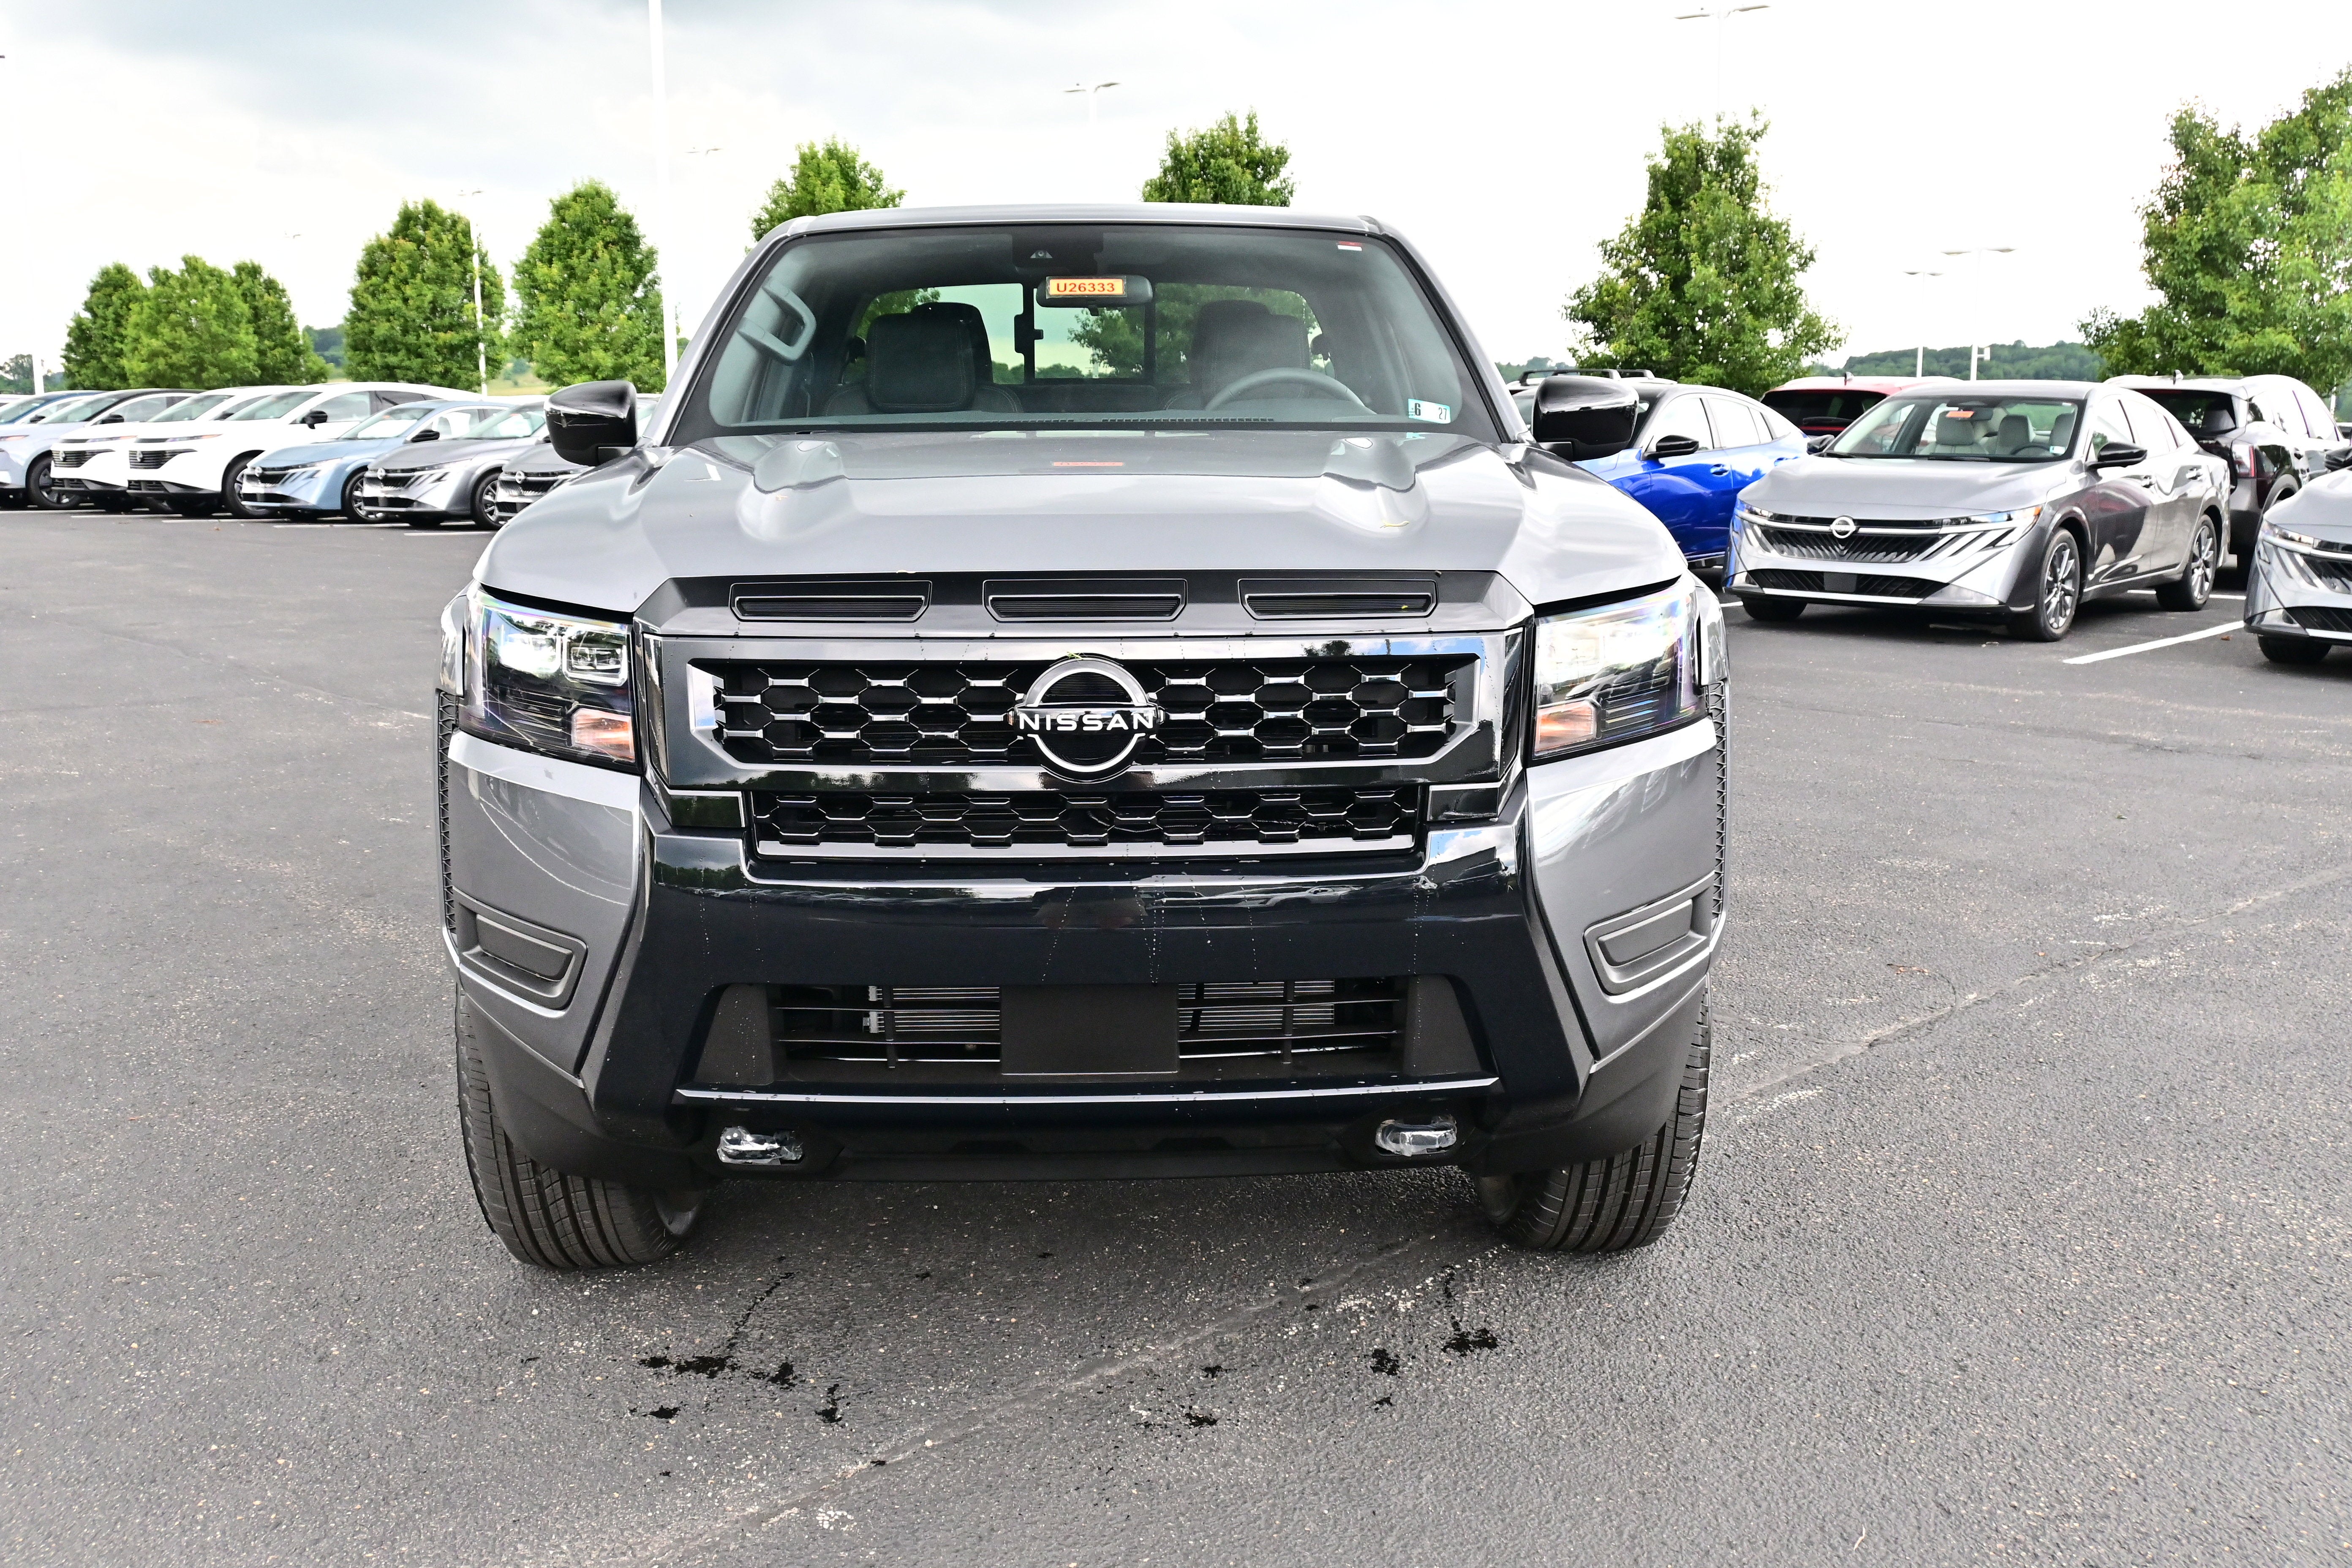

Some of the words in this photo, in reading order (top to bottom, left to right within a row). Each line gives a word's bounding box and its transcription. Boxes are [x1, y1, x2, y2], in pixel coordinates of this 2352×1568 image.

[1056, 283, 1115, 292] U26333
[1414, 403, 1421, 416] 6
[1438, 407, 1447, 420] 27
[1019, 713, 1153, 731] NISSAN
